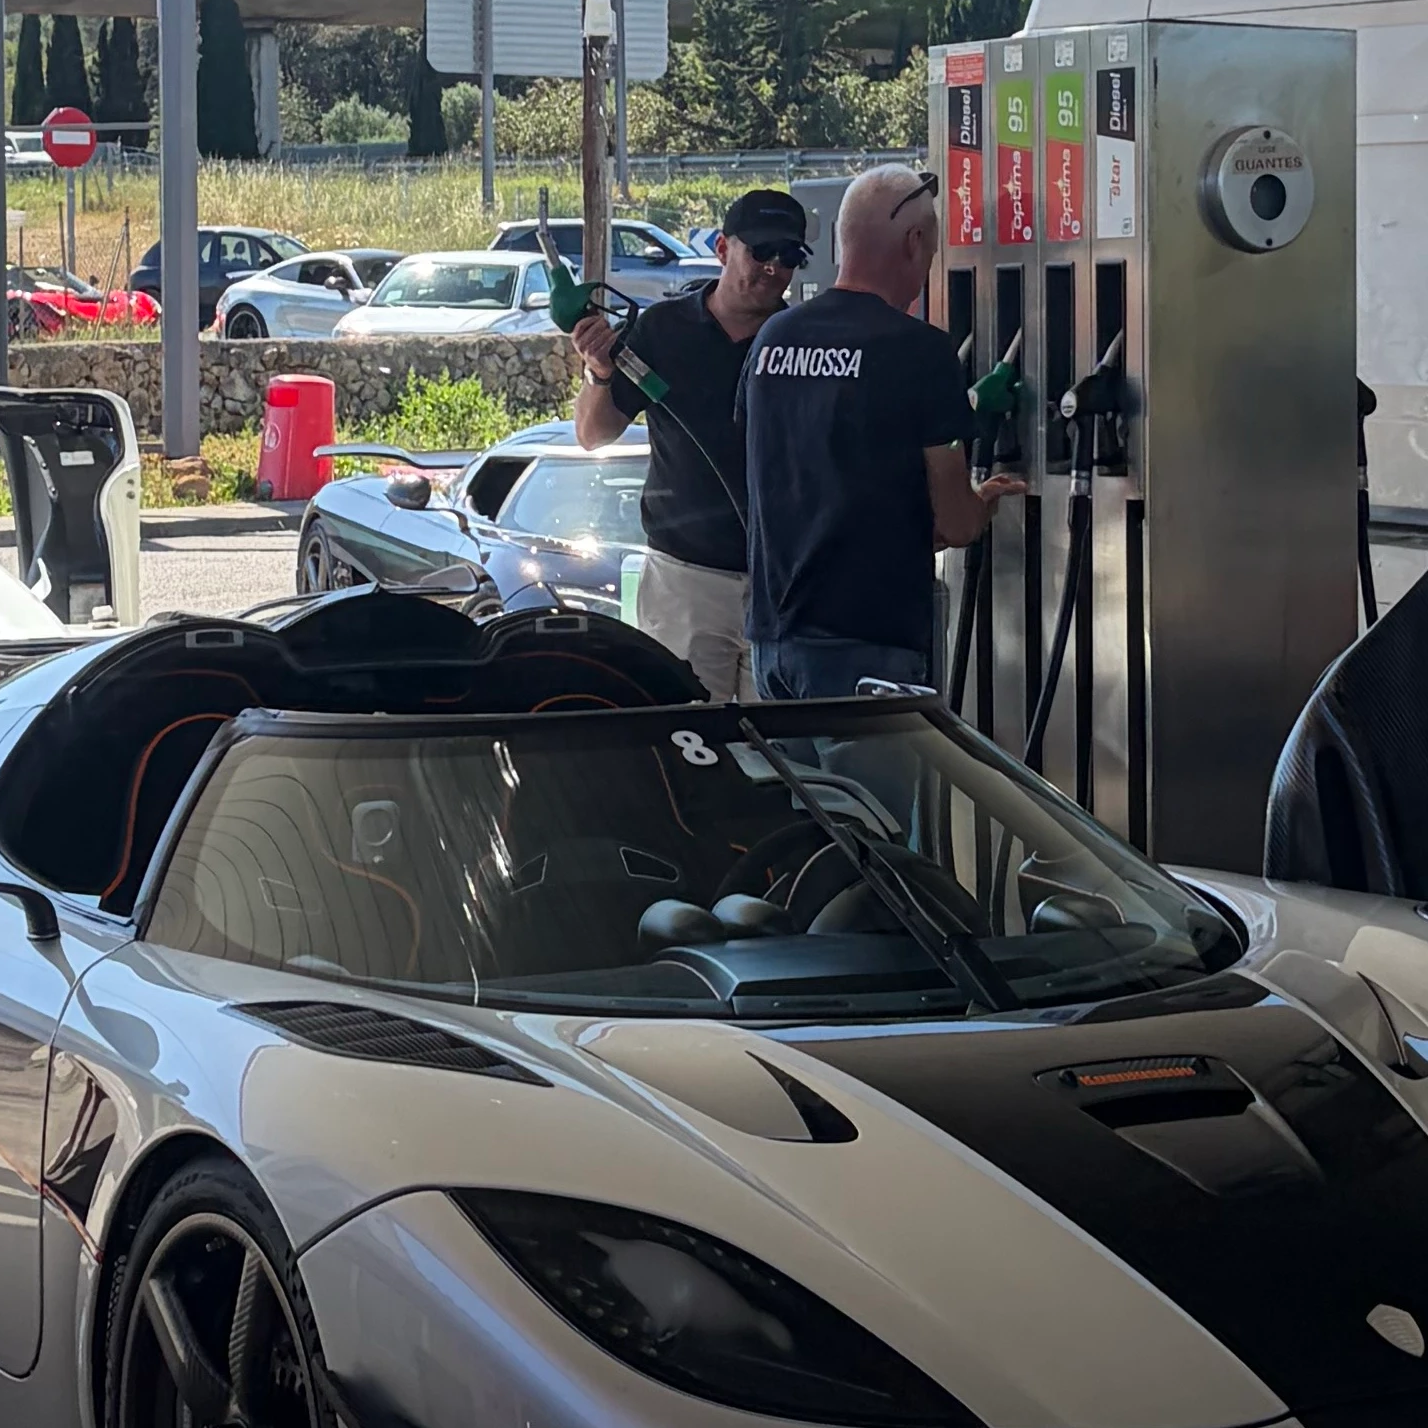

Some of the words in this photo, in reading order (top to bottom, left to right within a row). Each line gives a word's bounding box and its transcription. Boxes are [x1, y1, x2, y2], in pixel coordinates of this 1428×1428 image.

[1007, 95, 1024, 133] 95
[1057, 89, 1074, 127] 95
[1109, 72, 1121, 131] Diesel
[766, 346, 863, 379] CANOSSA
[670, 729, 719, 766] 8
